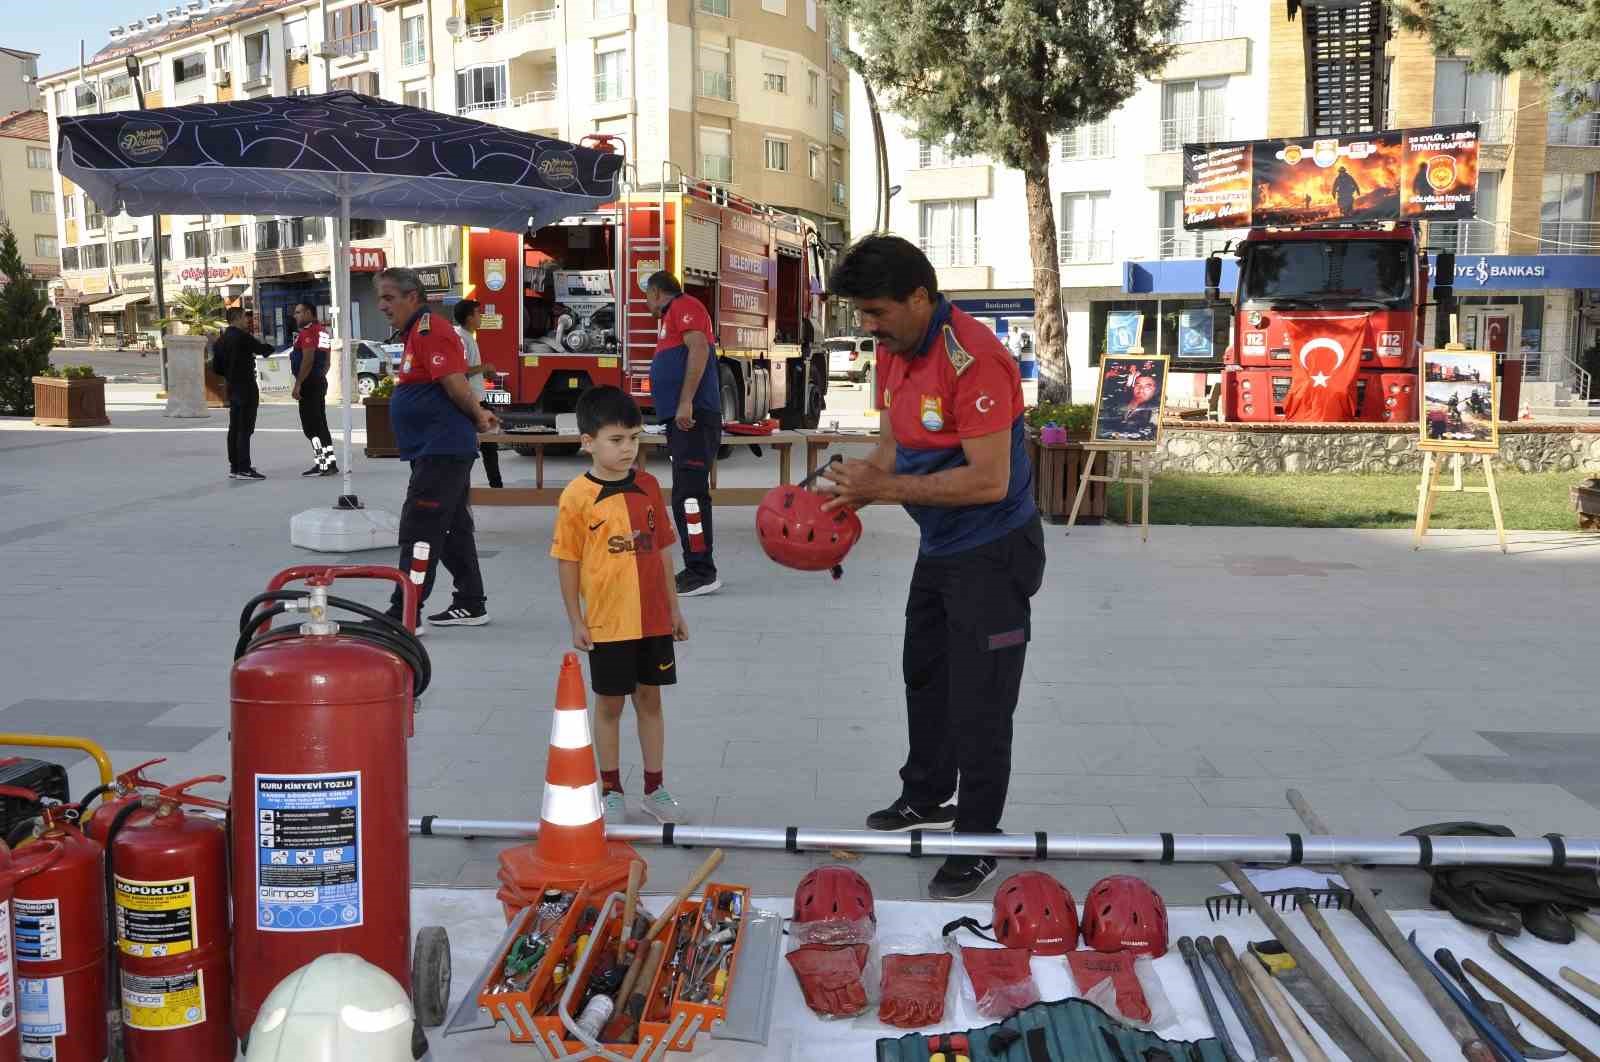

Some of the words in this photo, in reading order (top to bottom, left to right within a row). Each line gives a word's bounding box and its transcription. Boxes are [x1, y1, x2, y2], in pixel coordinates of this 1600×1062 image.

[1491, 266, 1545, 276] BANKASI
[1246, 334, 1263, 346] 112
[1381, 334, 1400, 346] 112
[260, 782, 283, 790] KURU
[284, 780, 322, 790] KİMYEVİ
[324, 780, 353, 788] TOZLU
[261, 888, 315, 899] olimpos
